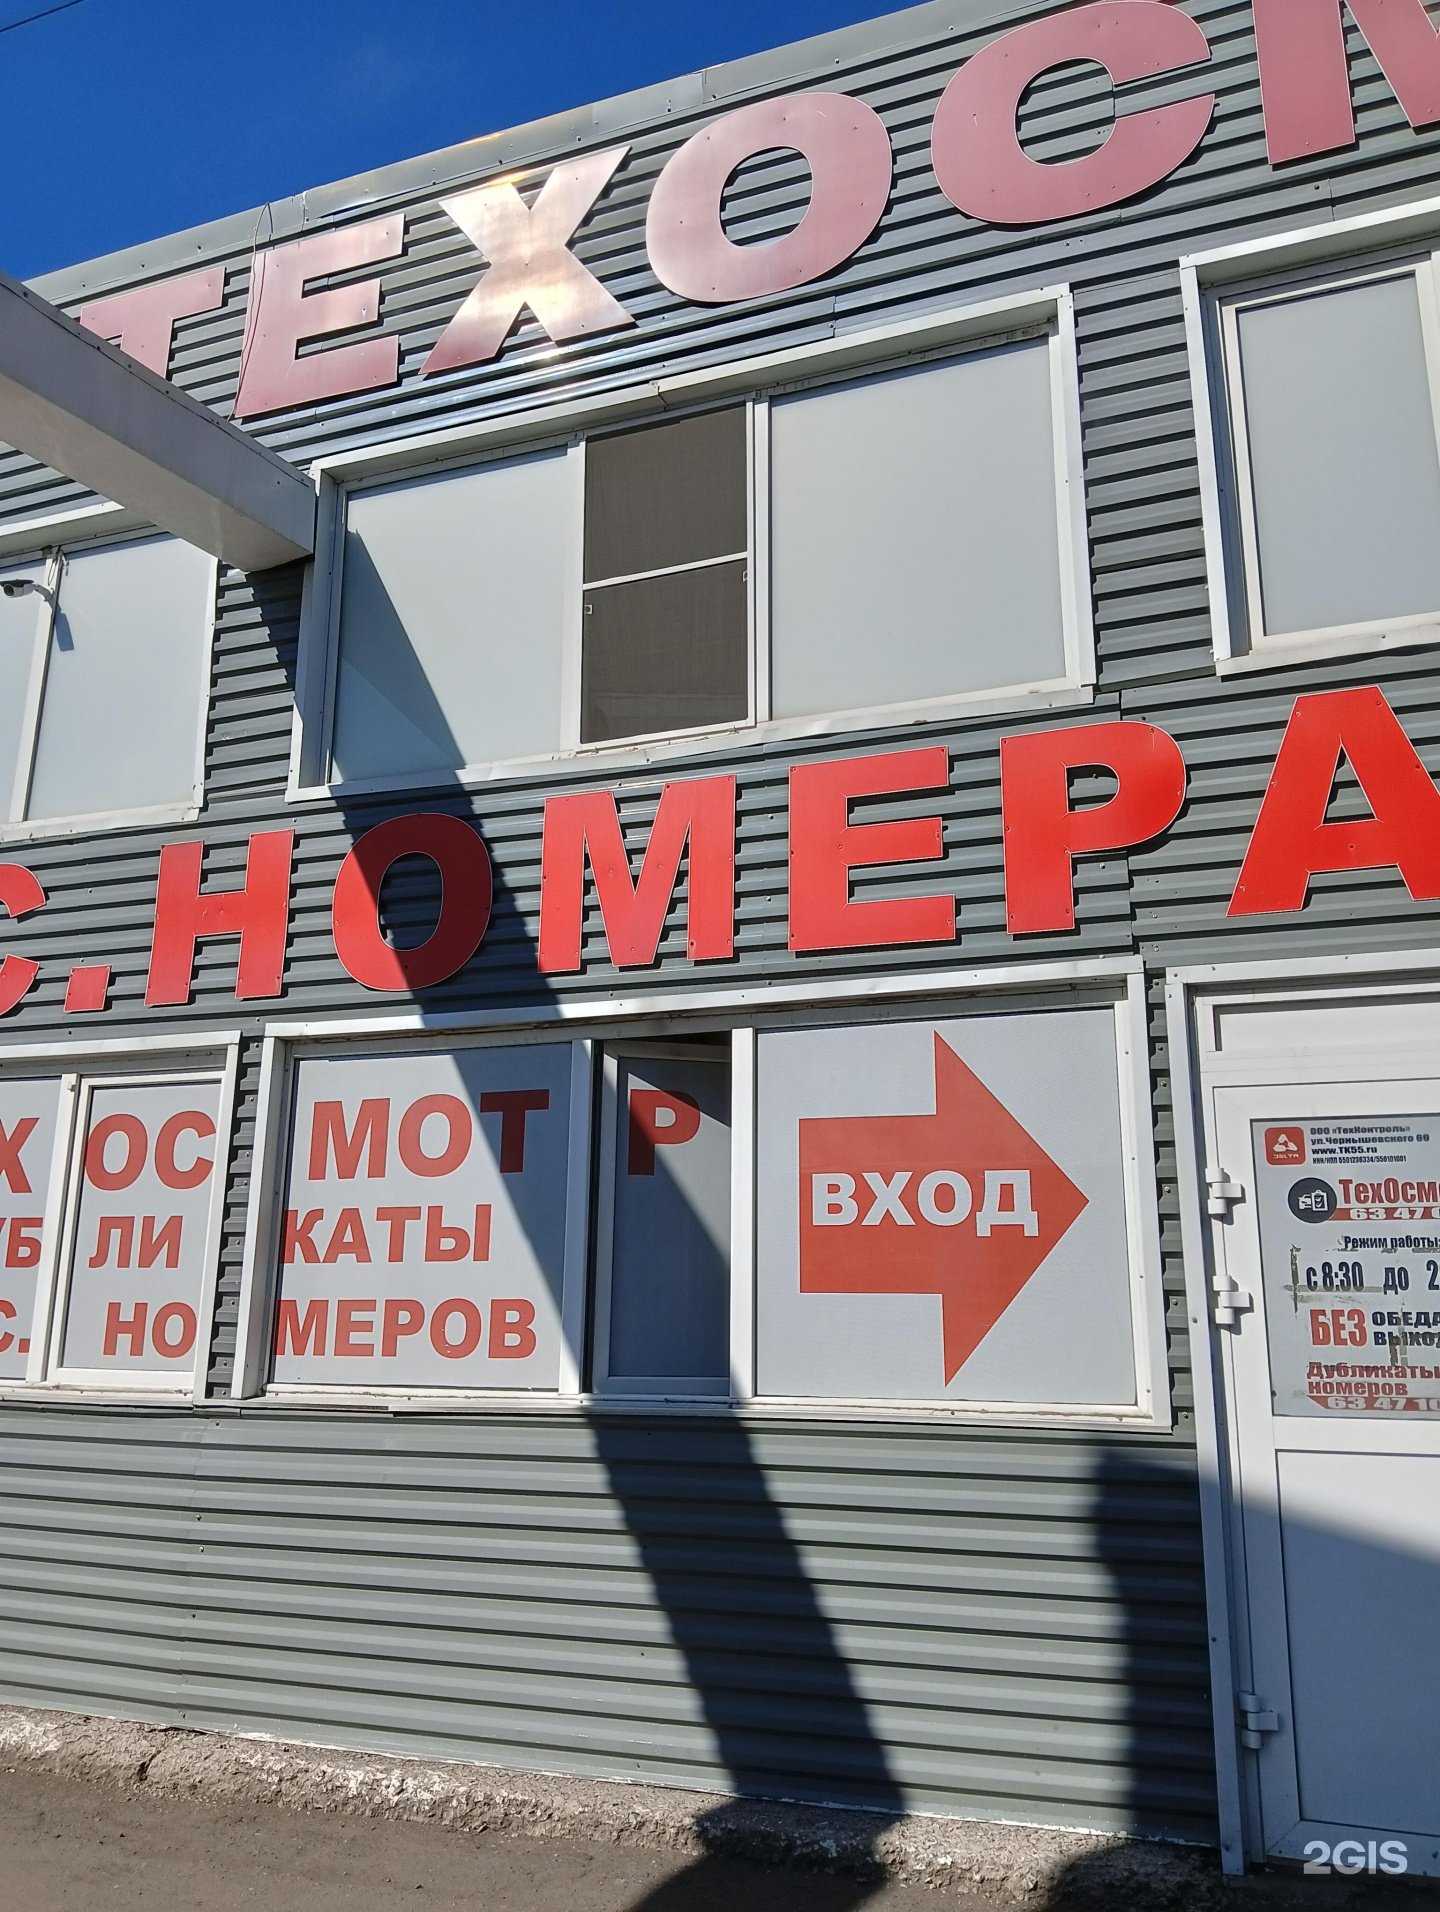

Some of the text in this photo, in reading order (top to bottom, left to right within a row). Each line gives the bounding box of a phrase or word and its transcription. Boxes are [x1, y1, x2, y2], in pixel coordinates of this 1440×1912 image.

[1339, 1177, 1440, 1205] ТехОсм
[811, 1169, 1039, 1238] ВХОД
[1350, 1208, 1386, 1220] 63
[1394, 1207, 1424, 1220] 47
[1344, 1235, 1388, 1249] Режим
[1322, 1261, 1365, 1292] 8:30
[1310, 1309, 1368, 1347] БЕЗ
[1307, 1361, 1440, 1379] Дубликаты
[1308, 1381, 1408, 1397] номеров
[1328, 1396, 1366, 1409] 63
[1373, 1397, 1407, 1410] 47
